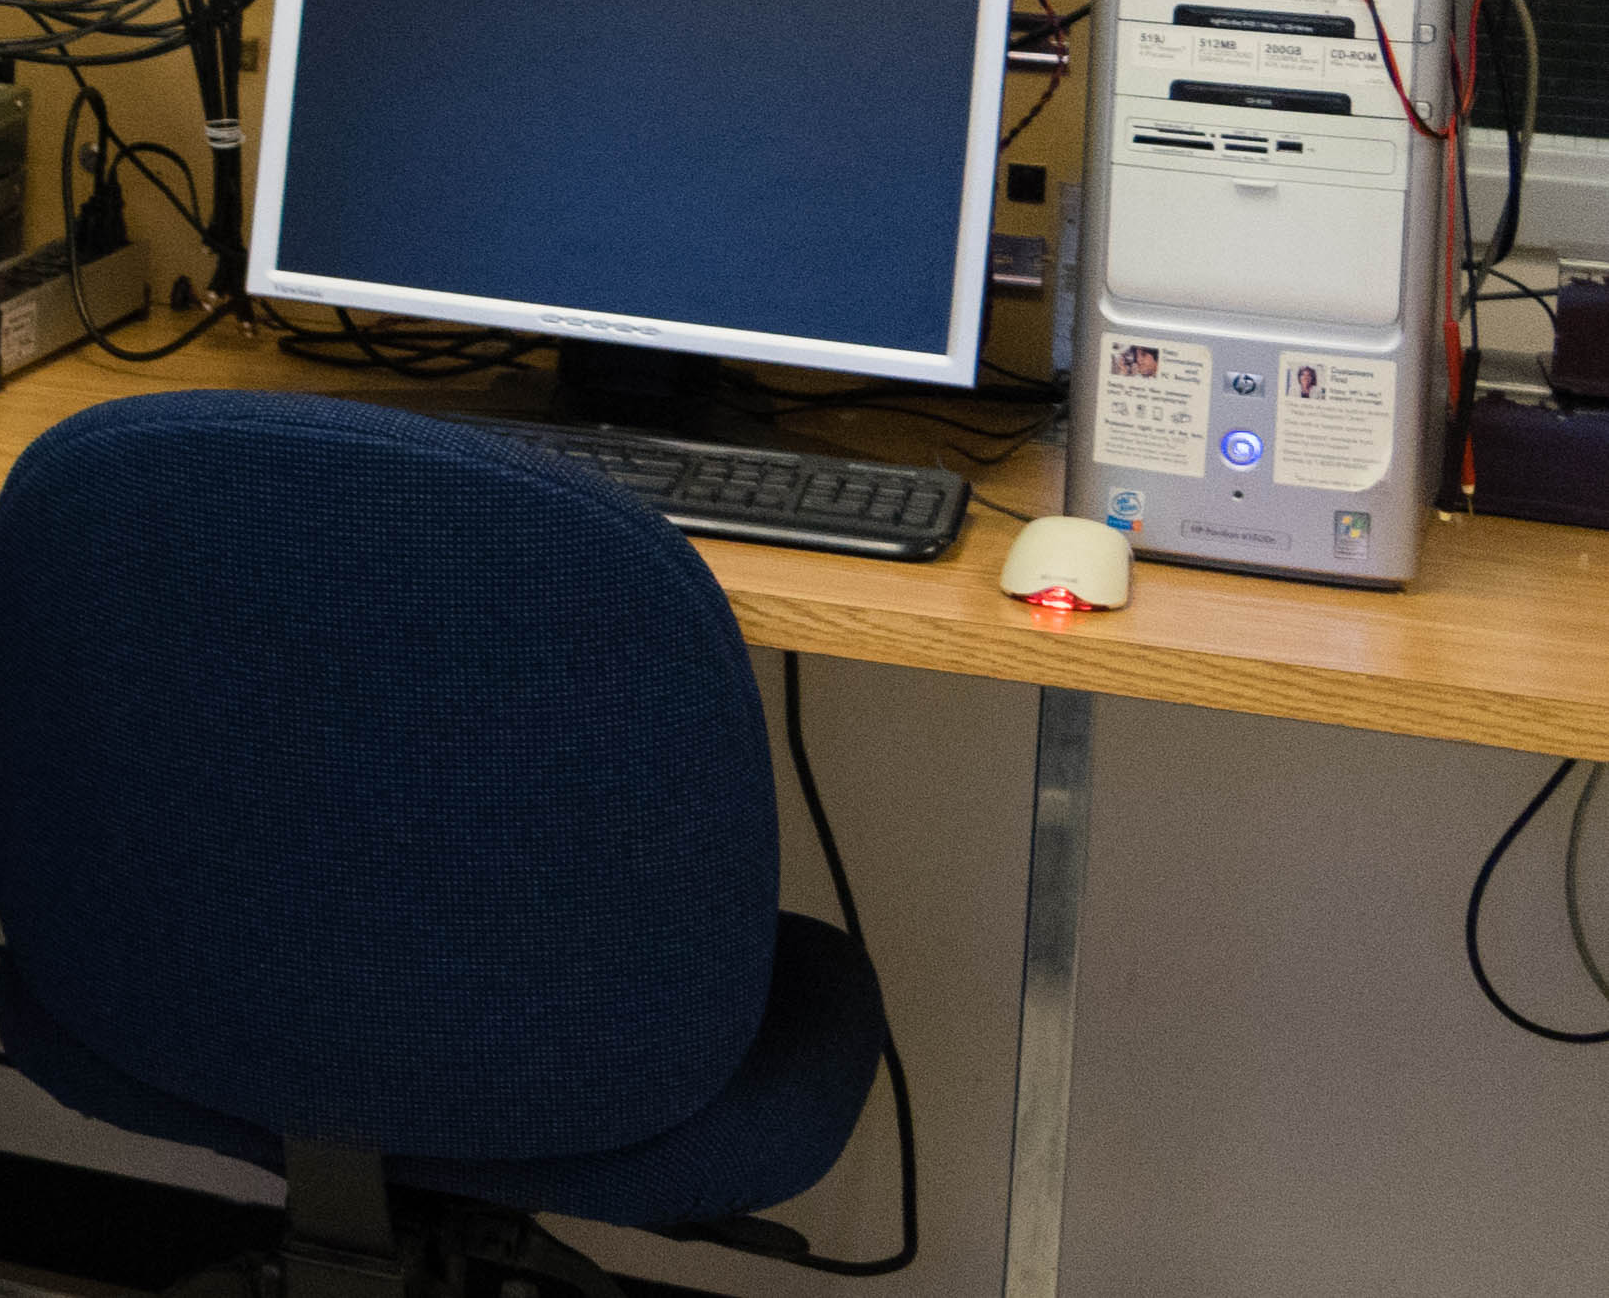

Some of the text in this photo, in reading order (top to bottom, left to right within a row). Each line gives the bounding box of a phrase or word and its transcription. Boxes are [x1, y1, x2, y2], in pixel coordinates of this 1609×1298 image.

[1199, 38, 1238, 50] 512MB
[1265, 43, 1302, 56] 200GB
[1331, 49, 1377, 62] CD-ROM
